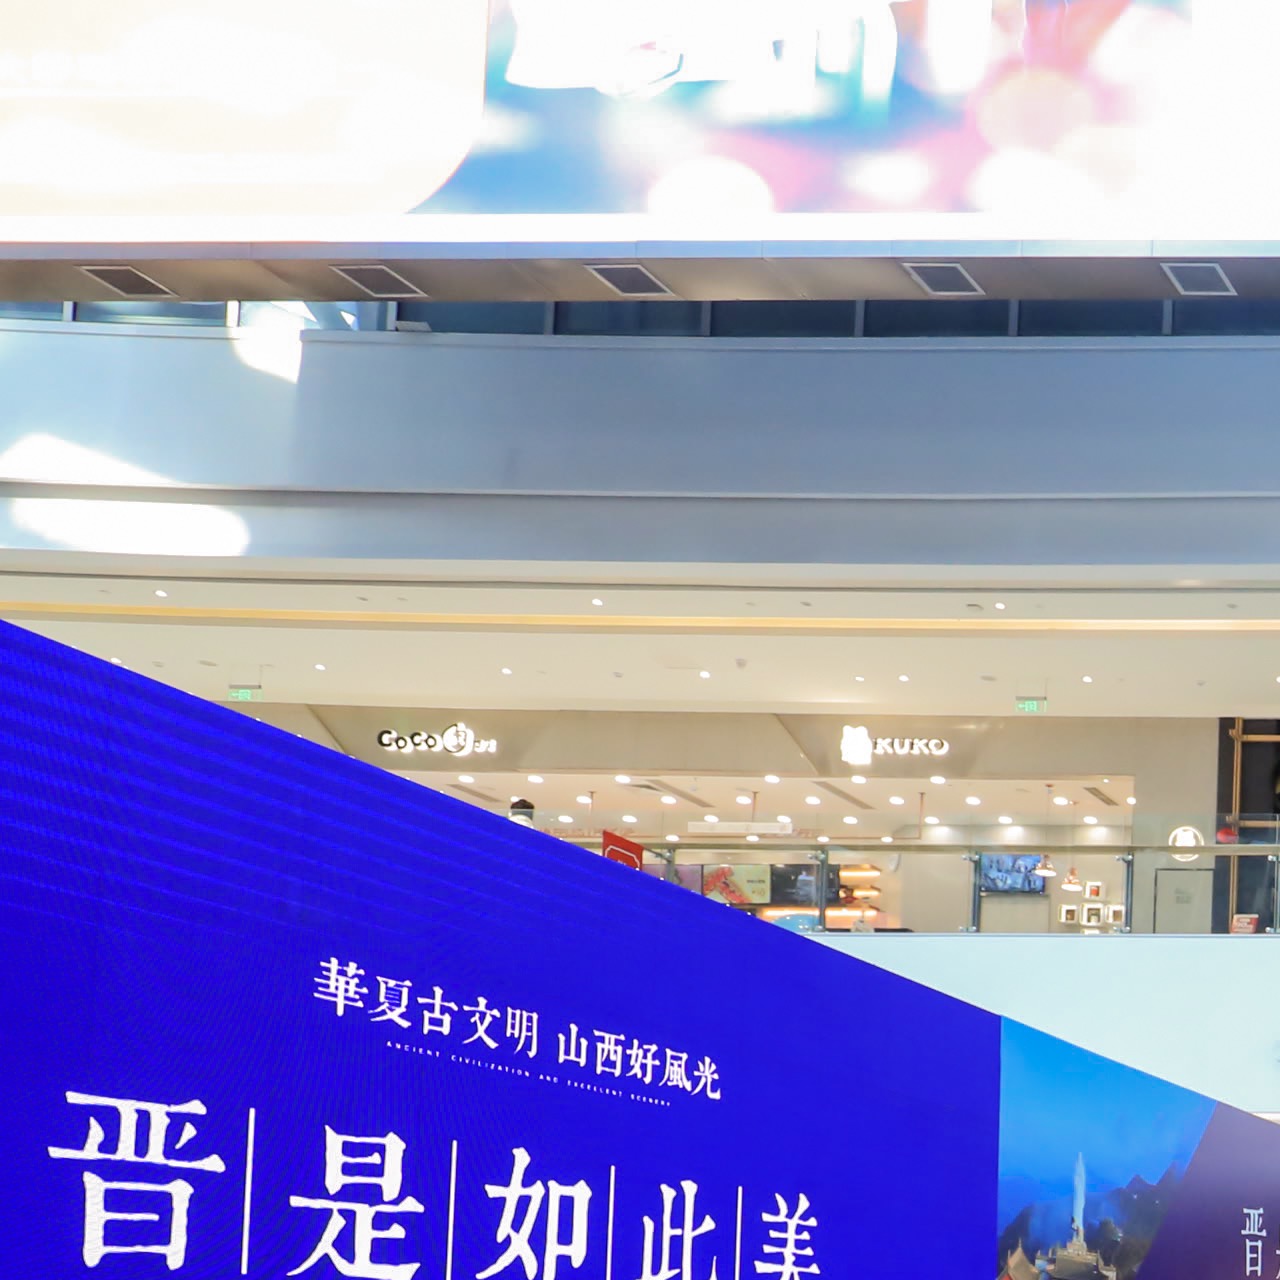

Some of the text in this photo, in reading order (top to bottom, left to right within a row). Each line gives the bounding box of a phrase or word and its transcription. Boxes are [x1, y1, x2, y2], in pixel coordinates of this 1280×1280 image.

[871, 737, 950, 755] KUKO
[557, 1023, 722, 1100] 山西好風光
